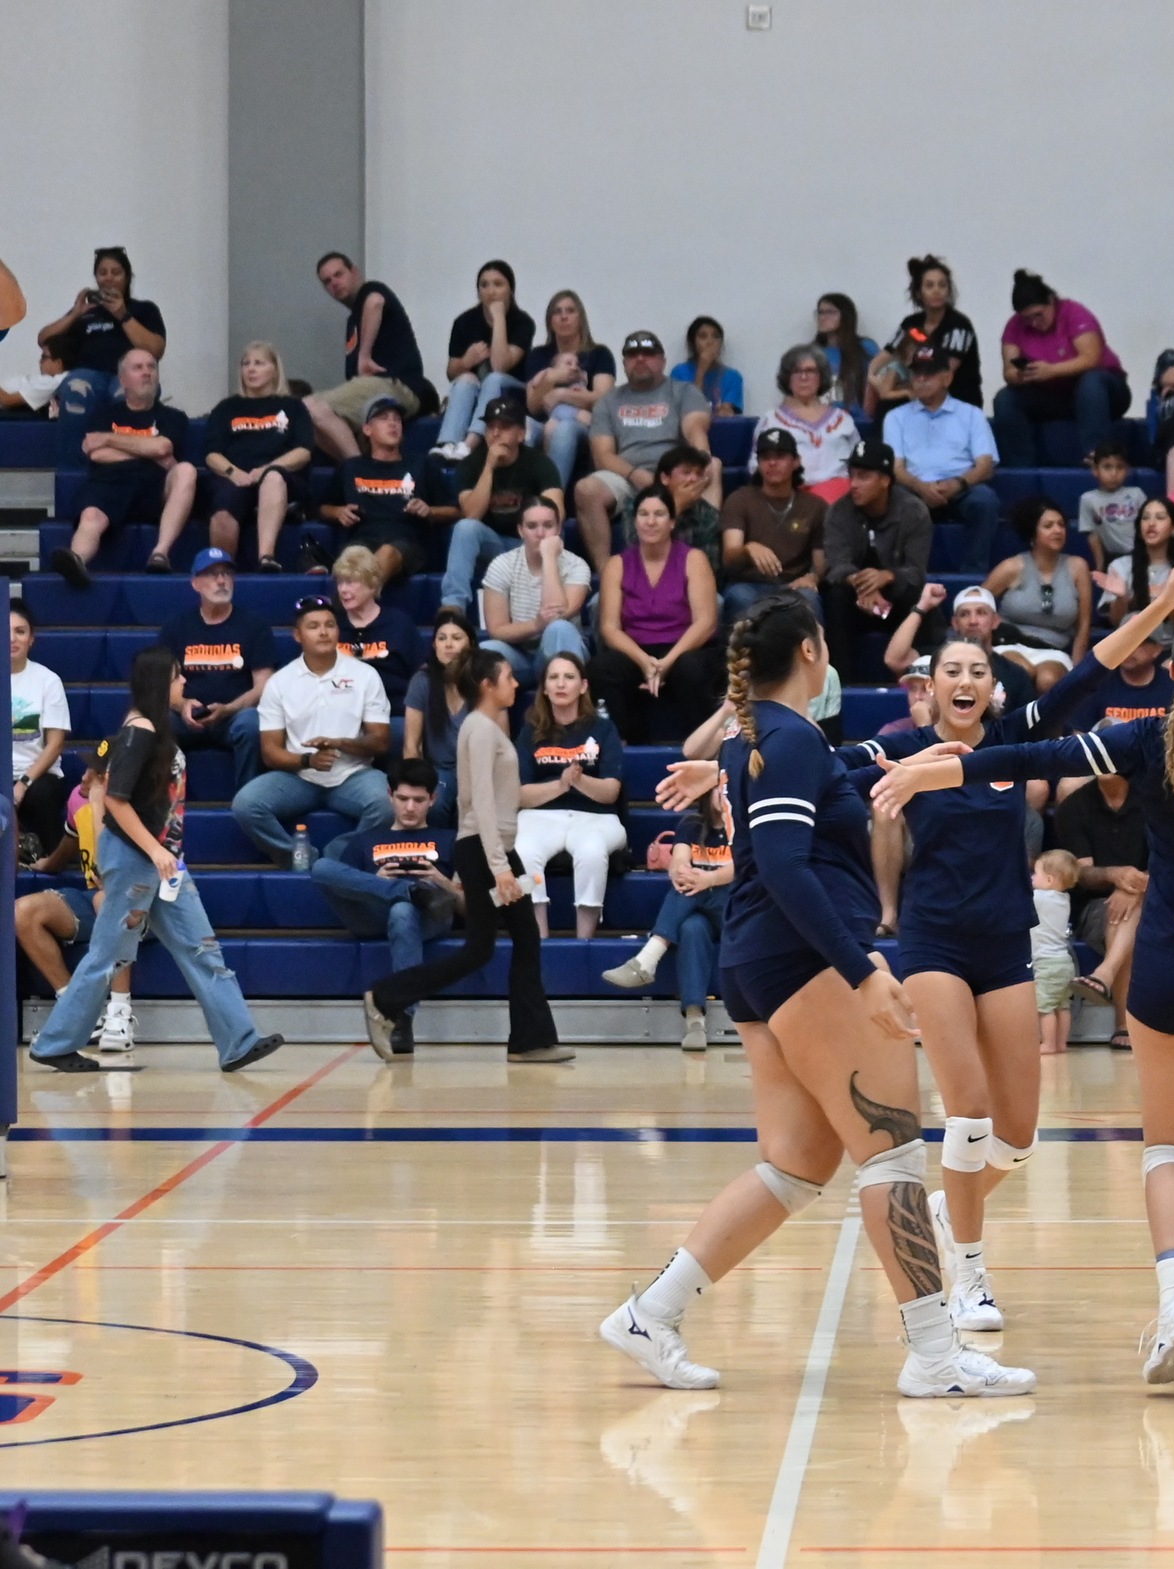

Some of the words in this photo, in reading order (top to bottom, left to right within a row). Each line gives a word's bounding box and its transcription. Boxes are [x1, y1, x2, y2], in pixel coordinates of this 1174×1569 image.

[185, 643, 241, 656] SEQUOIAS
[1105, 706, 1166, 719] SEQUOIAS
[373, 841, 436, 854] SEQUOIAS
